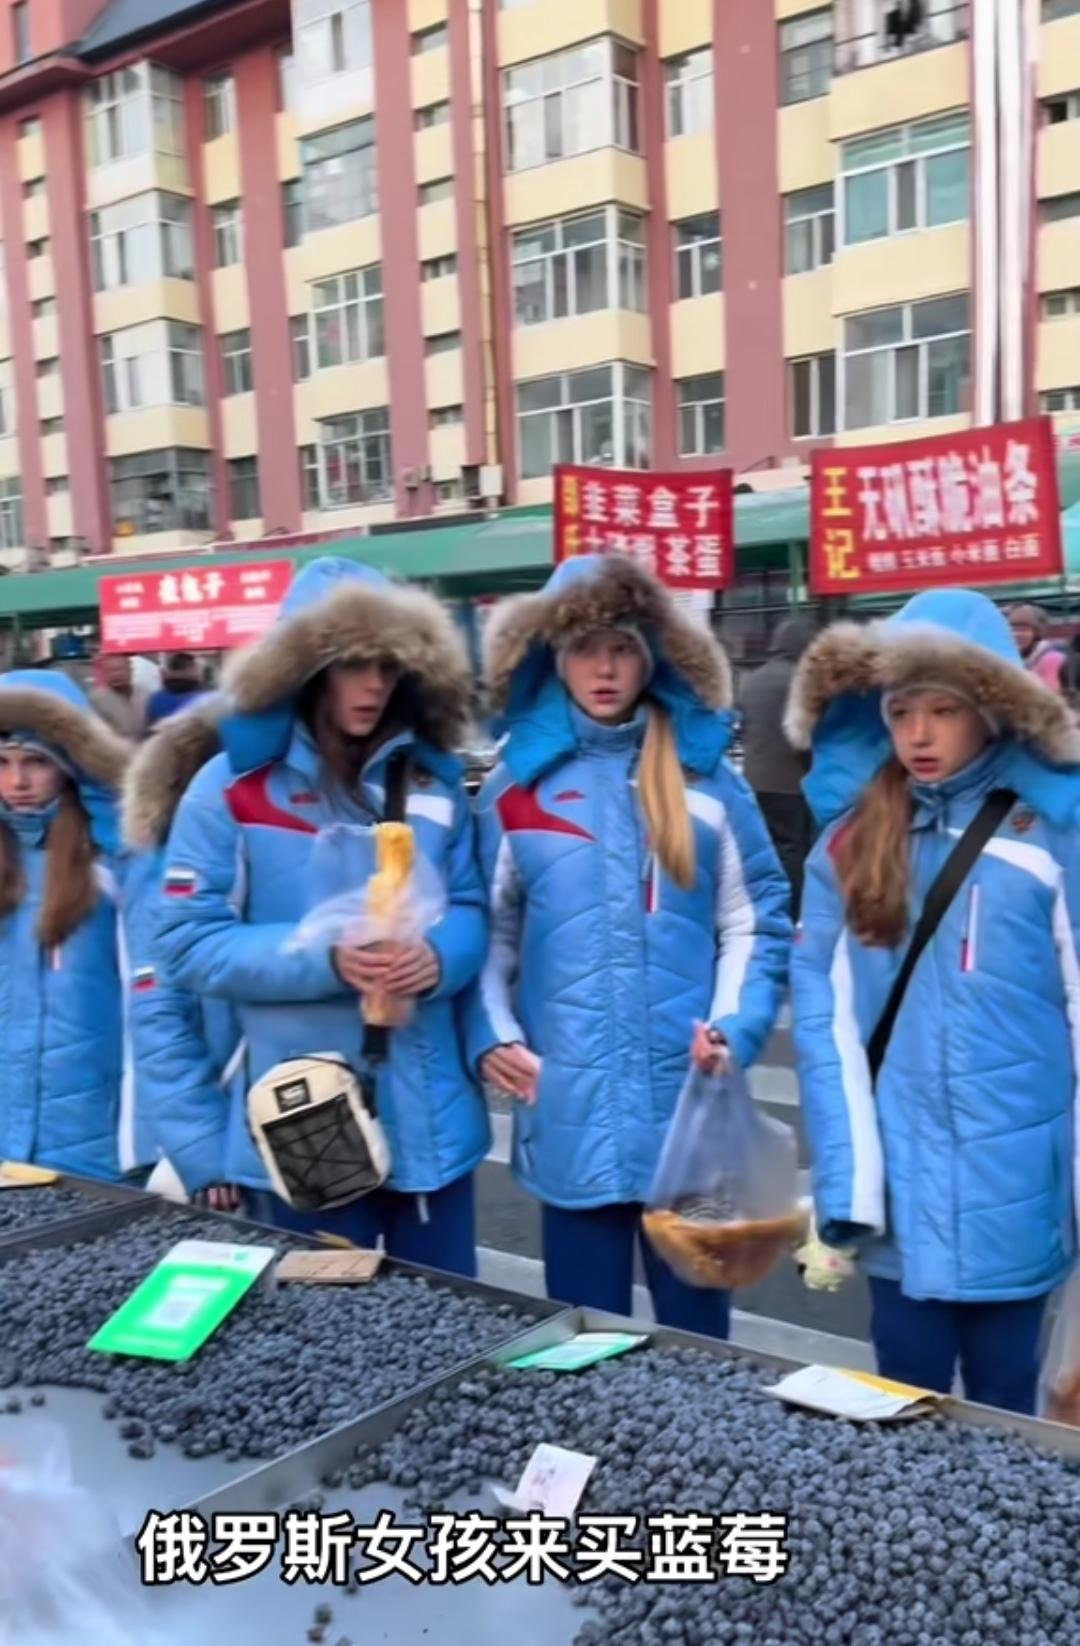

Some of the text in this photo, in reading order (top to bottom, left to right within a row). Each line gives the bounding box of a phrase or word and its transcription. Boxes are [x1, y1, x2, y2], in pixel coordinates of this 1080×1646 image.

[582, 481, 721, 528] 韭菜盒子
[821, 467, 860, 579] 王记
